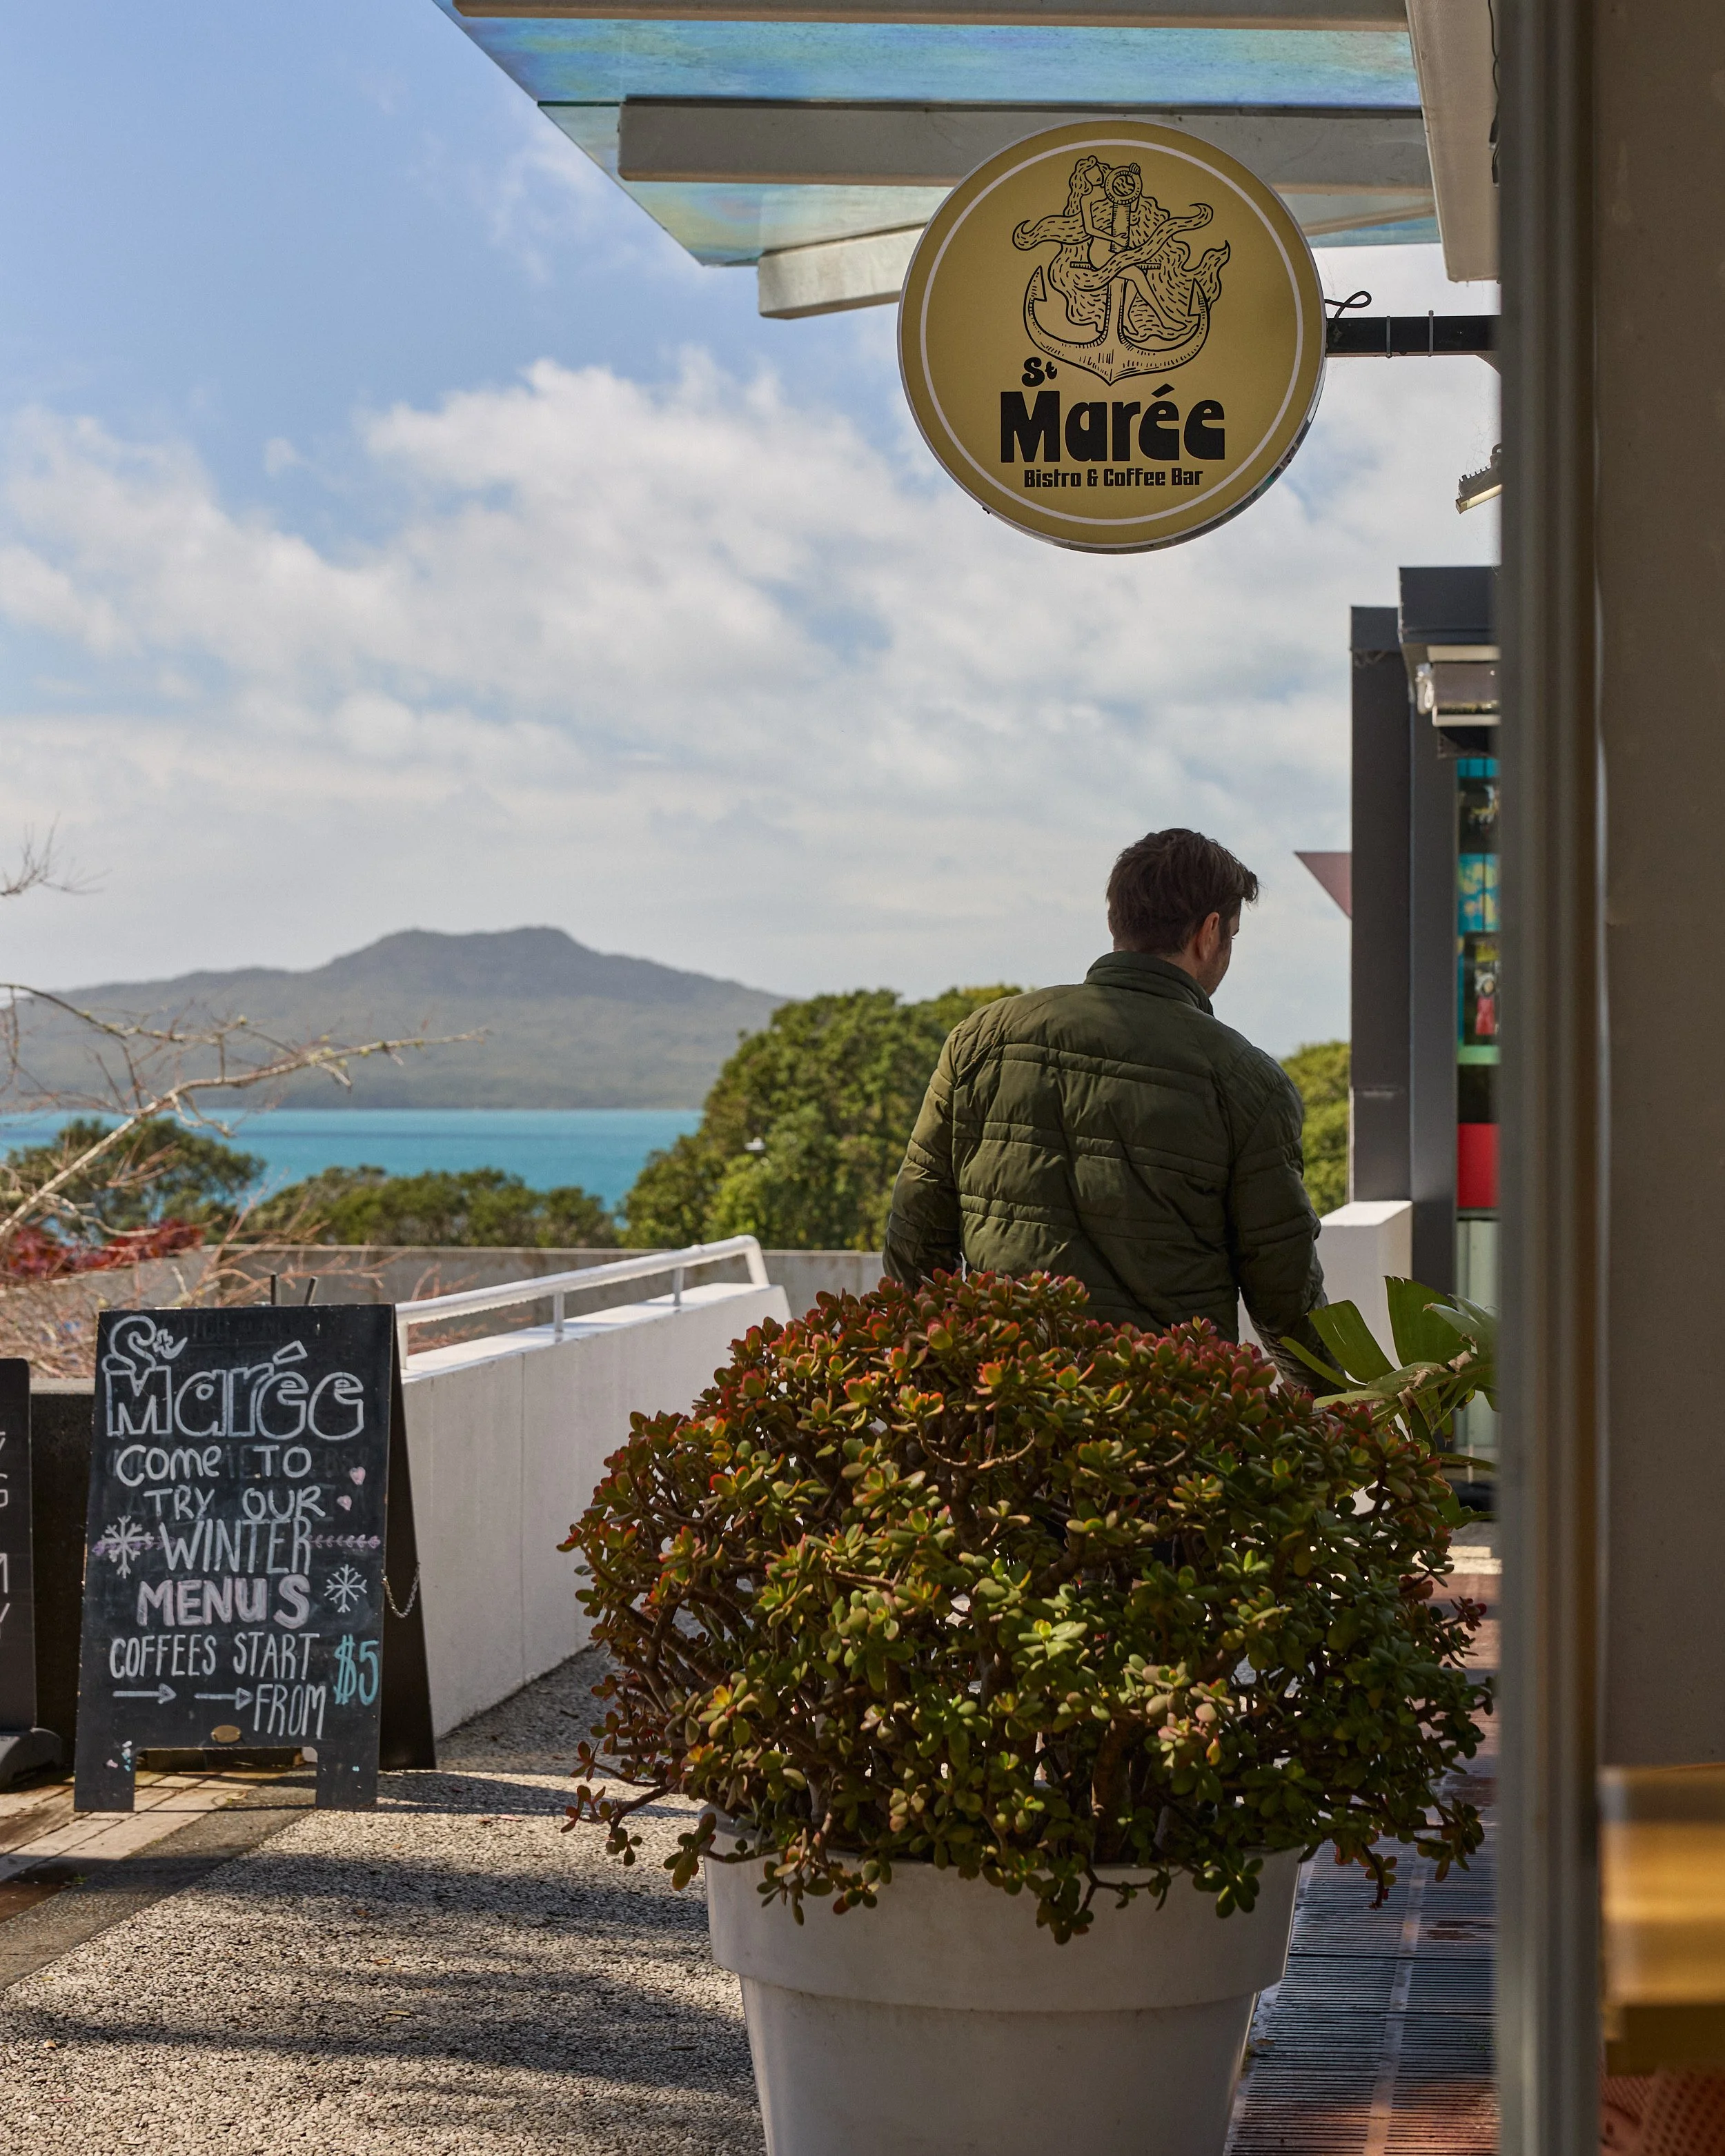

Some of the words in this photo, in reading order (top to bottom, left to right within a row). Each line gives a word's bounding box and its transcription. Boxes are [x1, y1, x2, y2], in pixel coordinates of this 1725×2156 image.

[1021, 357, 1058, 387] St
[1000, 384, 1225, 463] Marée
[1024, 469, 1081, 487] Bistro
[1087, 469, 1098, 487] &
[1104, 468, 1165, 486] Coffee
[1171, 468, 1203, 486] Bar
[101, 1315, 188, 1374] St
[106, 1340, 364, 1441] Marée
[253, 1445, 312, 1478] TO
[144, 1485, 215, 1520] TRY
[242, 1485, 326, 1520] OUR
[159, 1518, 311, 1575] WINTER
[137, 1574, 310, 1629] MENUS
[109, 1634, 216, 1679] COFFEES
[233, 1632, 320, 1681] START
[333, 1634, 379, 1705] $5
[254, 1683, 326, 1739] FROM
